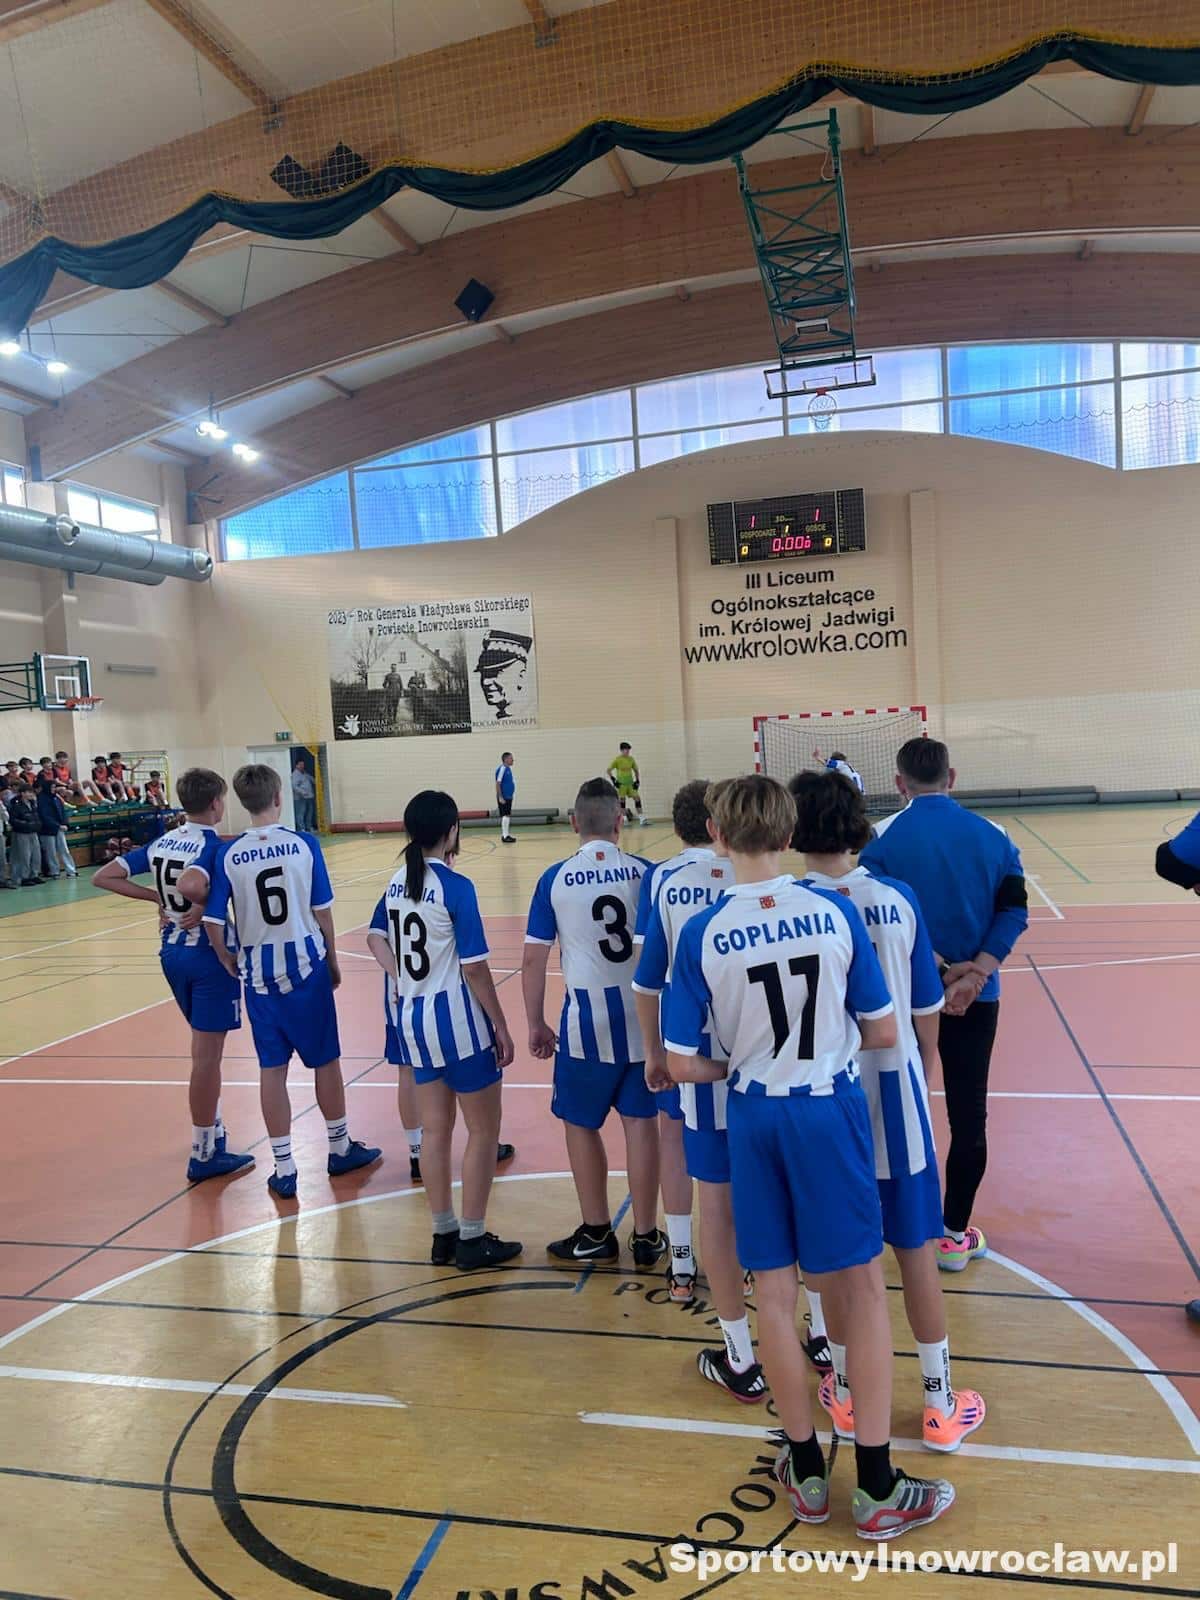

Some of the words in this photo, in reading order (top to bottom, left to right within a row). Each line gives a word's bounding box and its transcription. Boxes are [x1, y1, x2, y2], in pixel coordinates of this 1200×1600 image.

[745, 573, 761, 589] III
[767, 569, 835, 588] Liceum
[357, 610, 373, 622] Rok
[377, 606, 416, 620] Generała
[419, 603, 471, 617] Władysława
[474, 597, 530, 613] Sikorskiego
[711, 587, 876, 617] Ogólnokształcące
[377, 622, 415, 636] Powiecie
[418, 616, 490, 632] Inowrocławskim
[699, 622, 726, 638] im.
[731, 614, 811, 637] Królowej
[822, 606, 895, 629] Jadwigi
[684, 628, 908, 664] www.krolowka.com
[232, 843, 301, 866] GOPLANIA
[152, 856, 193, 912] 15
[564, 866, 642, 887] GOPLANIA
[255, 866, 289, 926] 6
[388, 909, 431, 982] 13
[591, 894, 634, 964] 3
[712, 912, 837, 956] GOPLANIA
[746, 953, 820, 1061] 17
